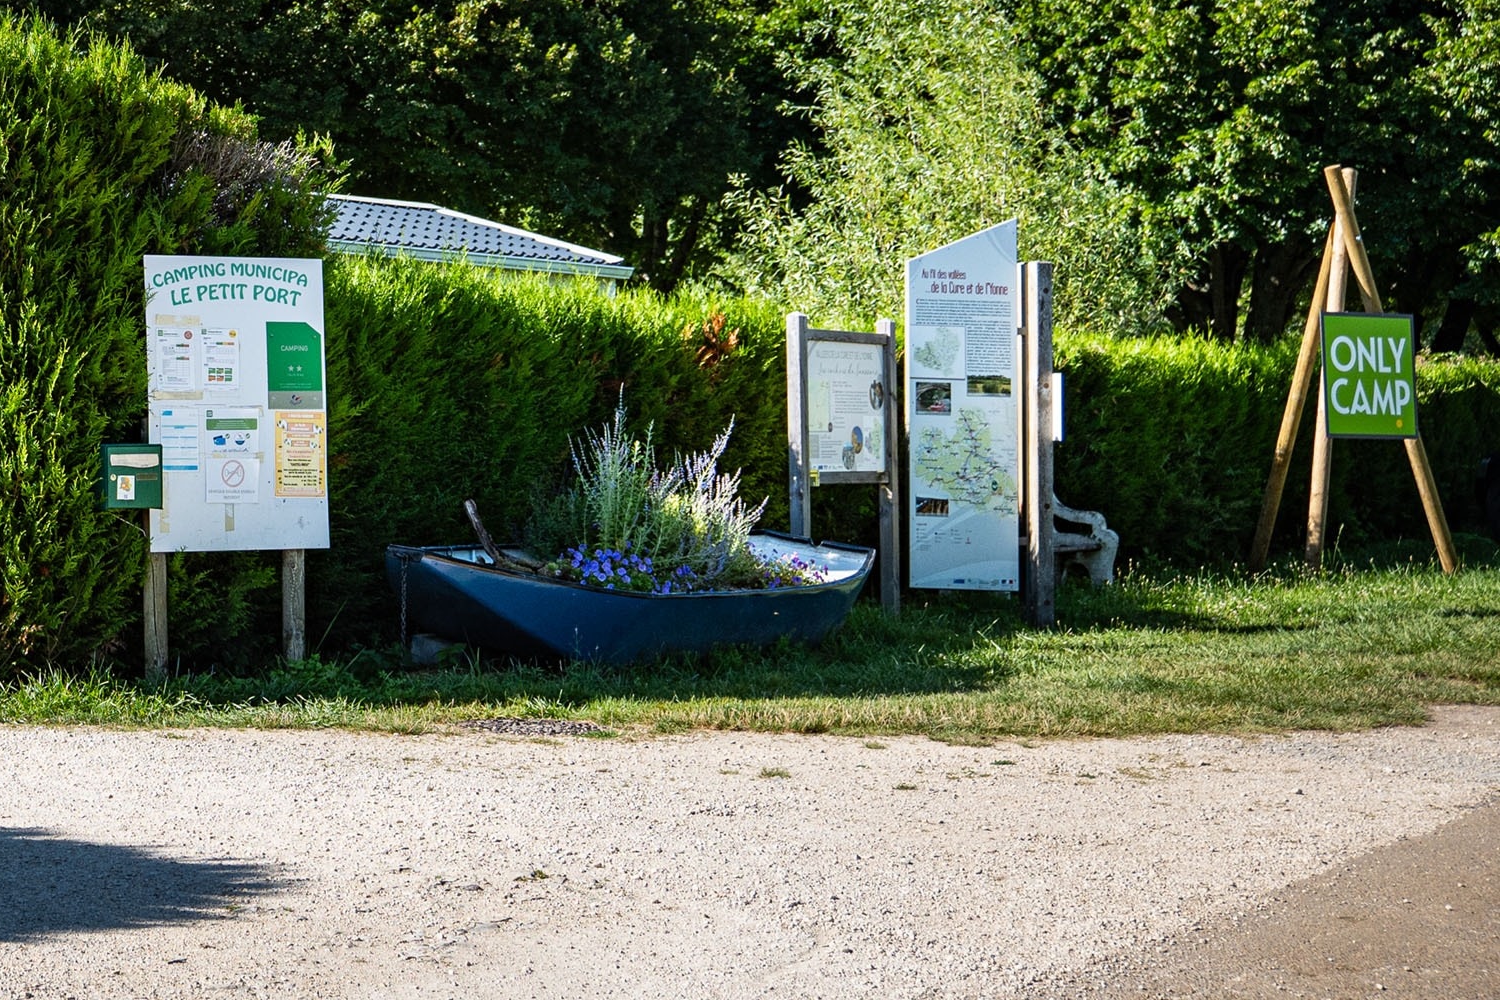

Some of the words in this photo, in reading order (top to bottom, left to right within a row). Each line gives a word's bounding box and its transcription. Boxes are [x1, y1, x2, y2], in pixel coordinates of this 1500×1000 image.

[152, 263, 226, 287] CAMPING
[230, 263, 308, 287] MUNICIPA
[937, 269, 947, 280] des
[170, 287, 192, 306] LE
[196, 283, 248, 301] PETIT
[253, 286, 302, 306] PORT
[941, 281, 948, 294] la
[949, 281, 965, 294] Cure
[966, 283, 974, 295] et
[975, 282, 984, 295] de
[280, 344, 308, 352] CAMPING
[1330, 335, 1406, 373] ONLY
[1330, 377, 1411, 415] CAMP
